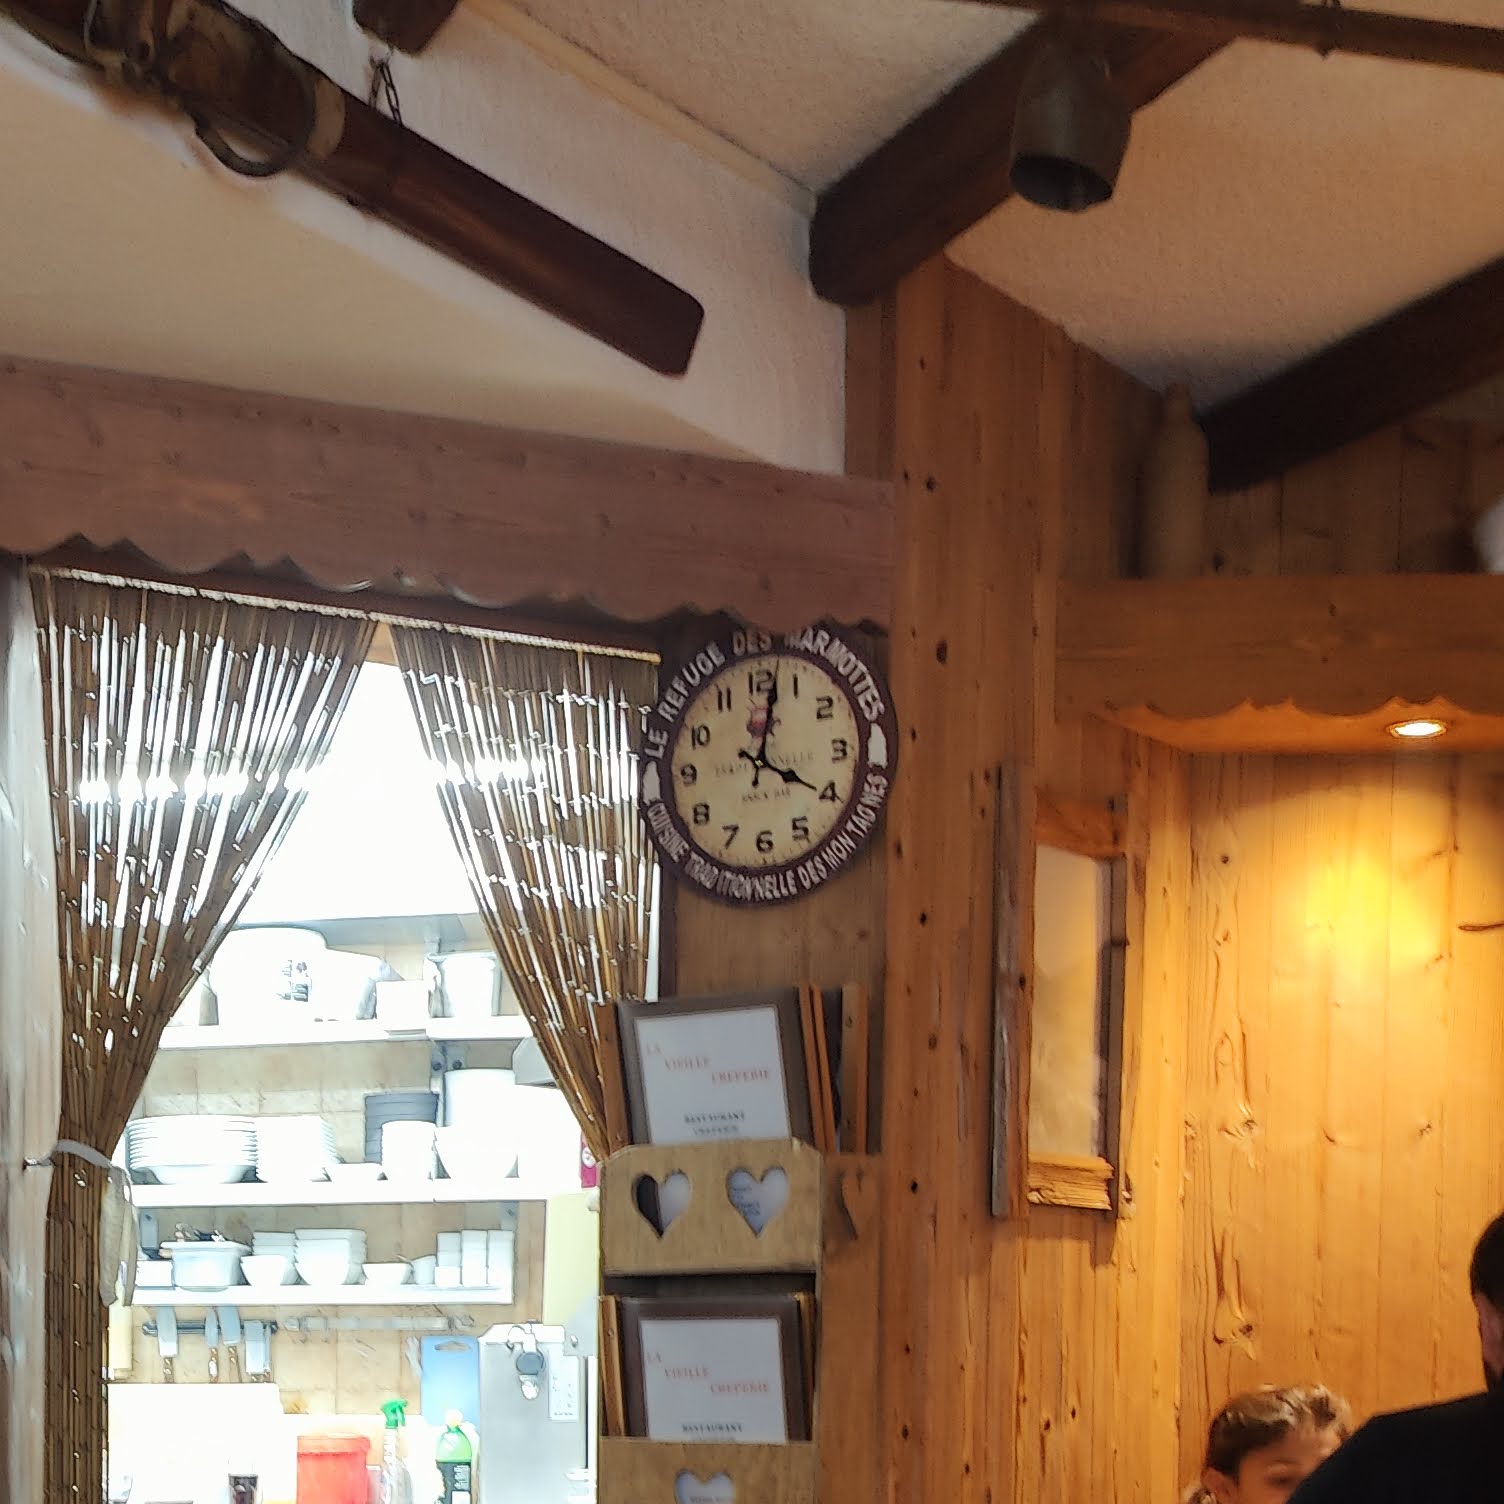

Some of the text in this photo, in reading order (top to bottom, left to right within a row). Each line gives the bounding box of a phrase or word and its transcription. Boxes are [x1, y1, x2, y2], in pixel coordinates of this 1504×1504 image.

[645, 725, 670, 759] LE
[732, 628, 773, 657] DES
[747, 669, 775, 694] 12
[791, 673, 800, 698] 1
[716, 687, 732, 712] 11
[816, 696, 835, 720] 2
[691, 724, 711, 749] 10
[832, 738, 848, 762] 3
[680, 763, 698, 786] 9
[818, 780, 839, 804] 4
[692, 803, 710, 826] 8
[721, 824, 740, 850] 7
[791, 816, 810, 842] 5
[647, 801, 687, 864] CUISINE
[797, 856, 826, 890] DES
[755, 830, 774, 855] 6
